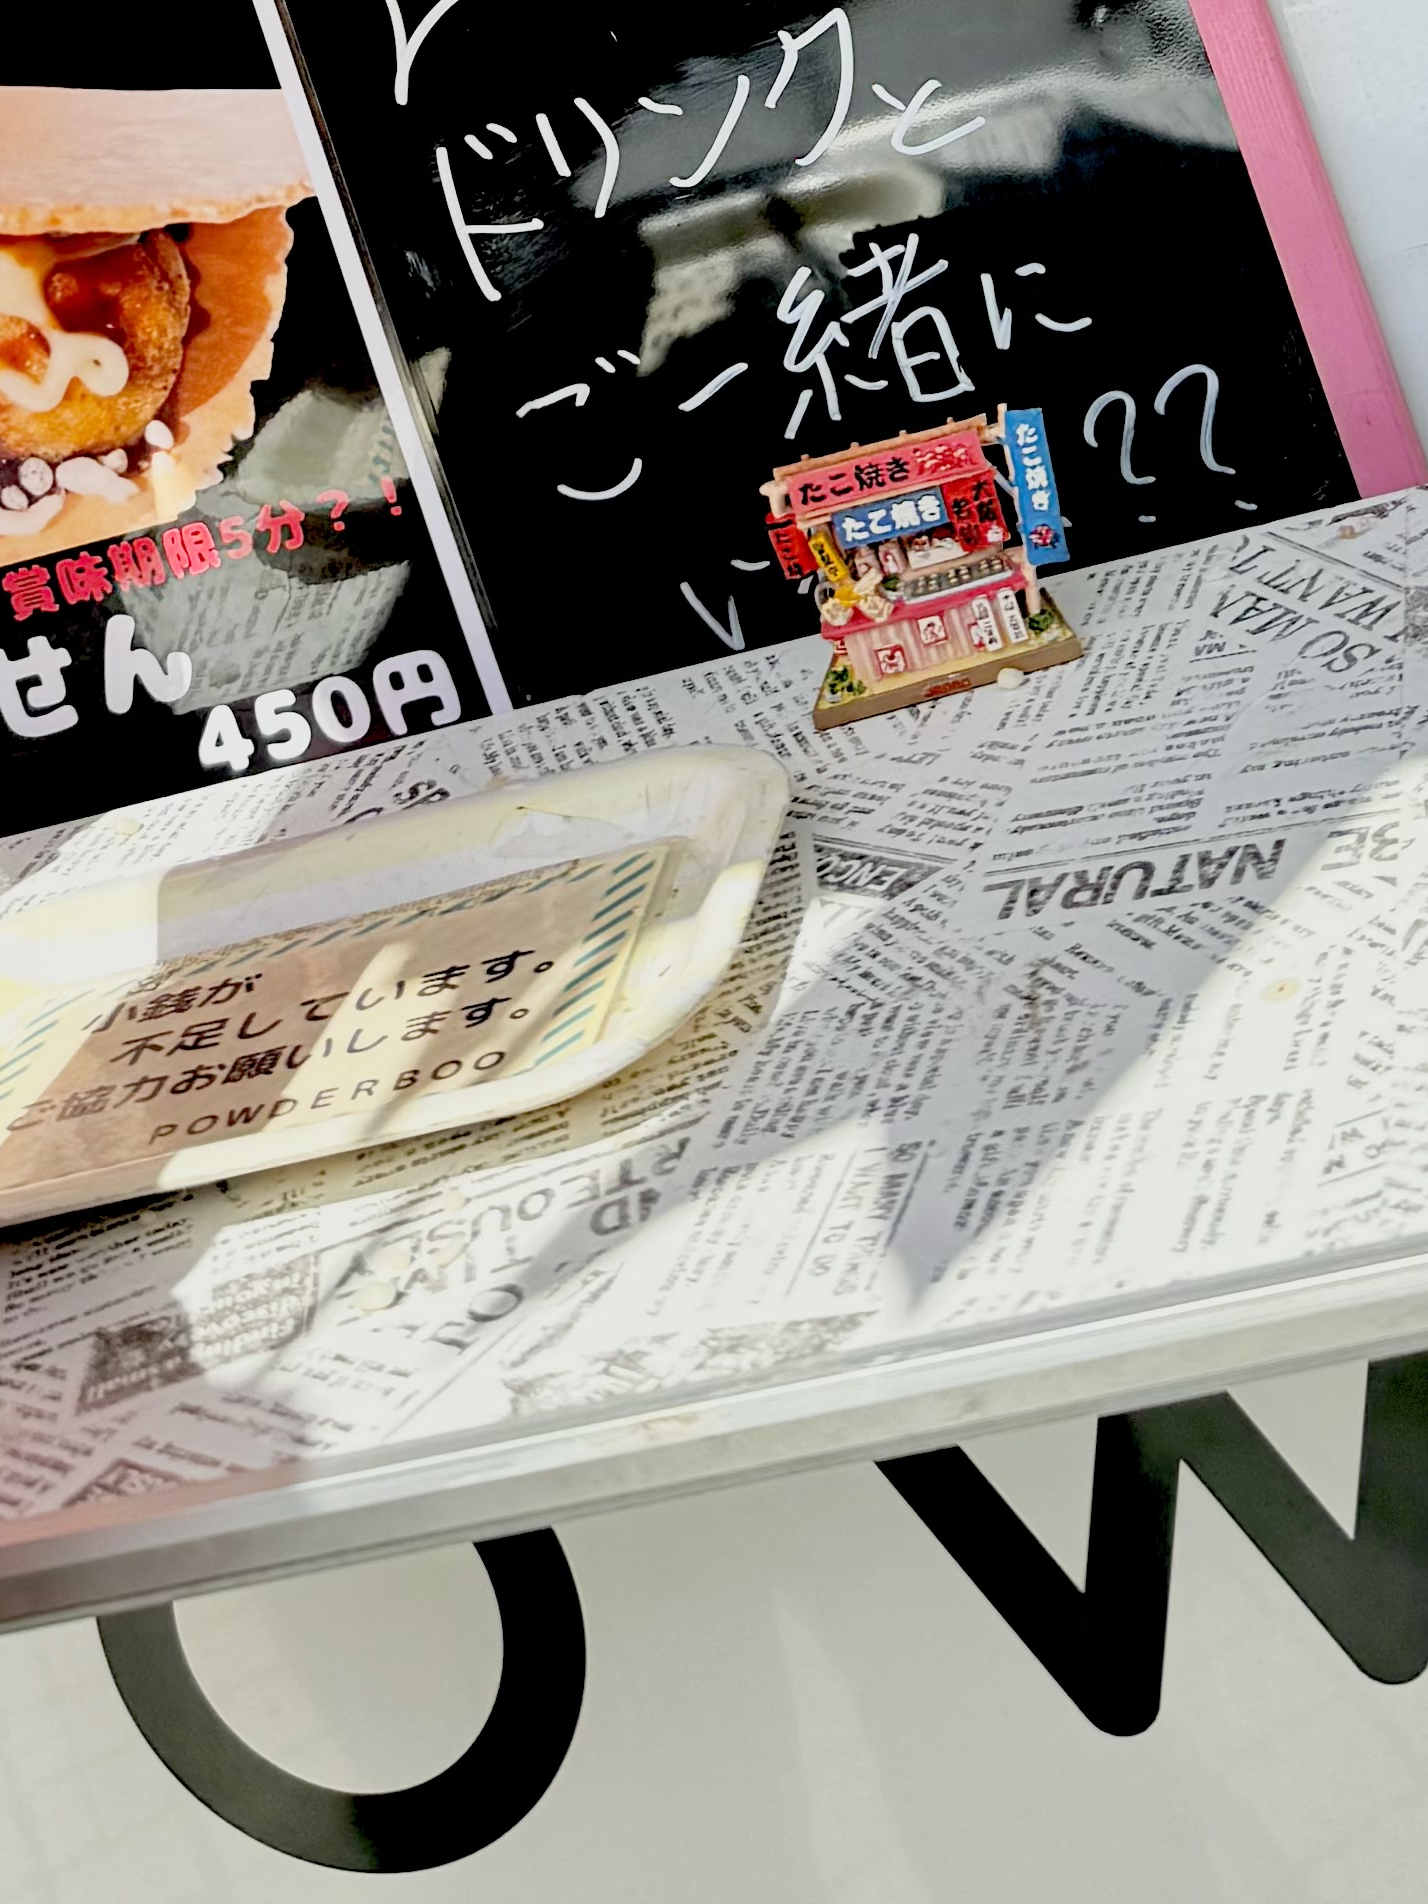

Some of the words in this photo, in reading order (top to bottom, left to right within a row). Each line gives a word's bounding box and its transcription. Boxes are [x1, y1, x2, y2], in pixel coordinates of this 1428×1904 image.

[434, 7, 987, 302] ドリンクと
[514, 232, 1093, 503] ご一緒に
[798, 456, 910, 506] たこ焼き
[1273, 562, 1403, 630] WANT
[1296, 628, 1378, 676] SO
[197, 648, 462, 774] 450円
[981, 837, 1287, 920] NATURAL
[5, 995, 531, 1134] ご協力お願いします。
[110, 948, 556, 1068] 不足しています。
